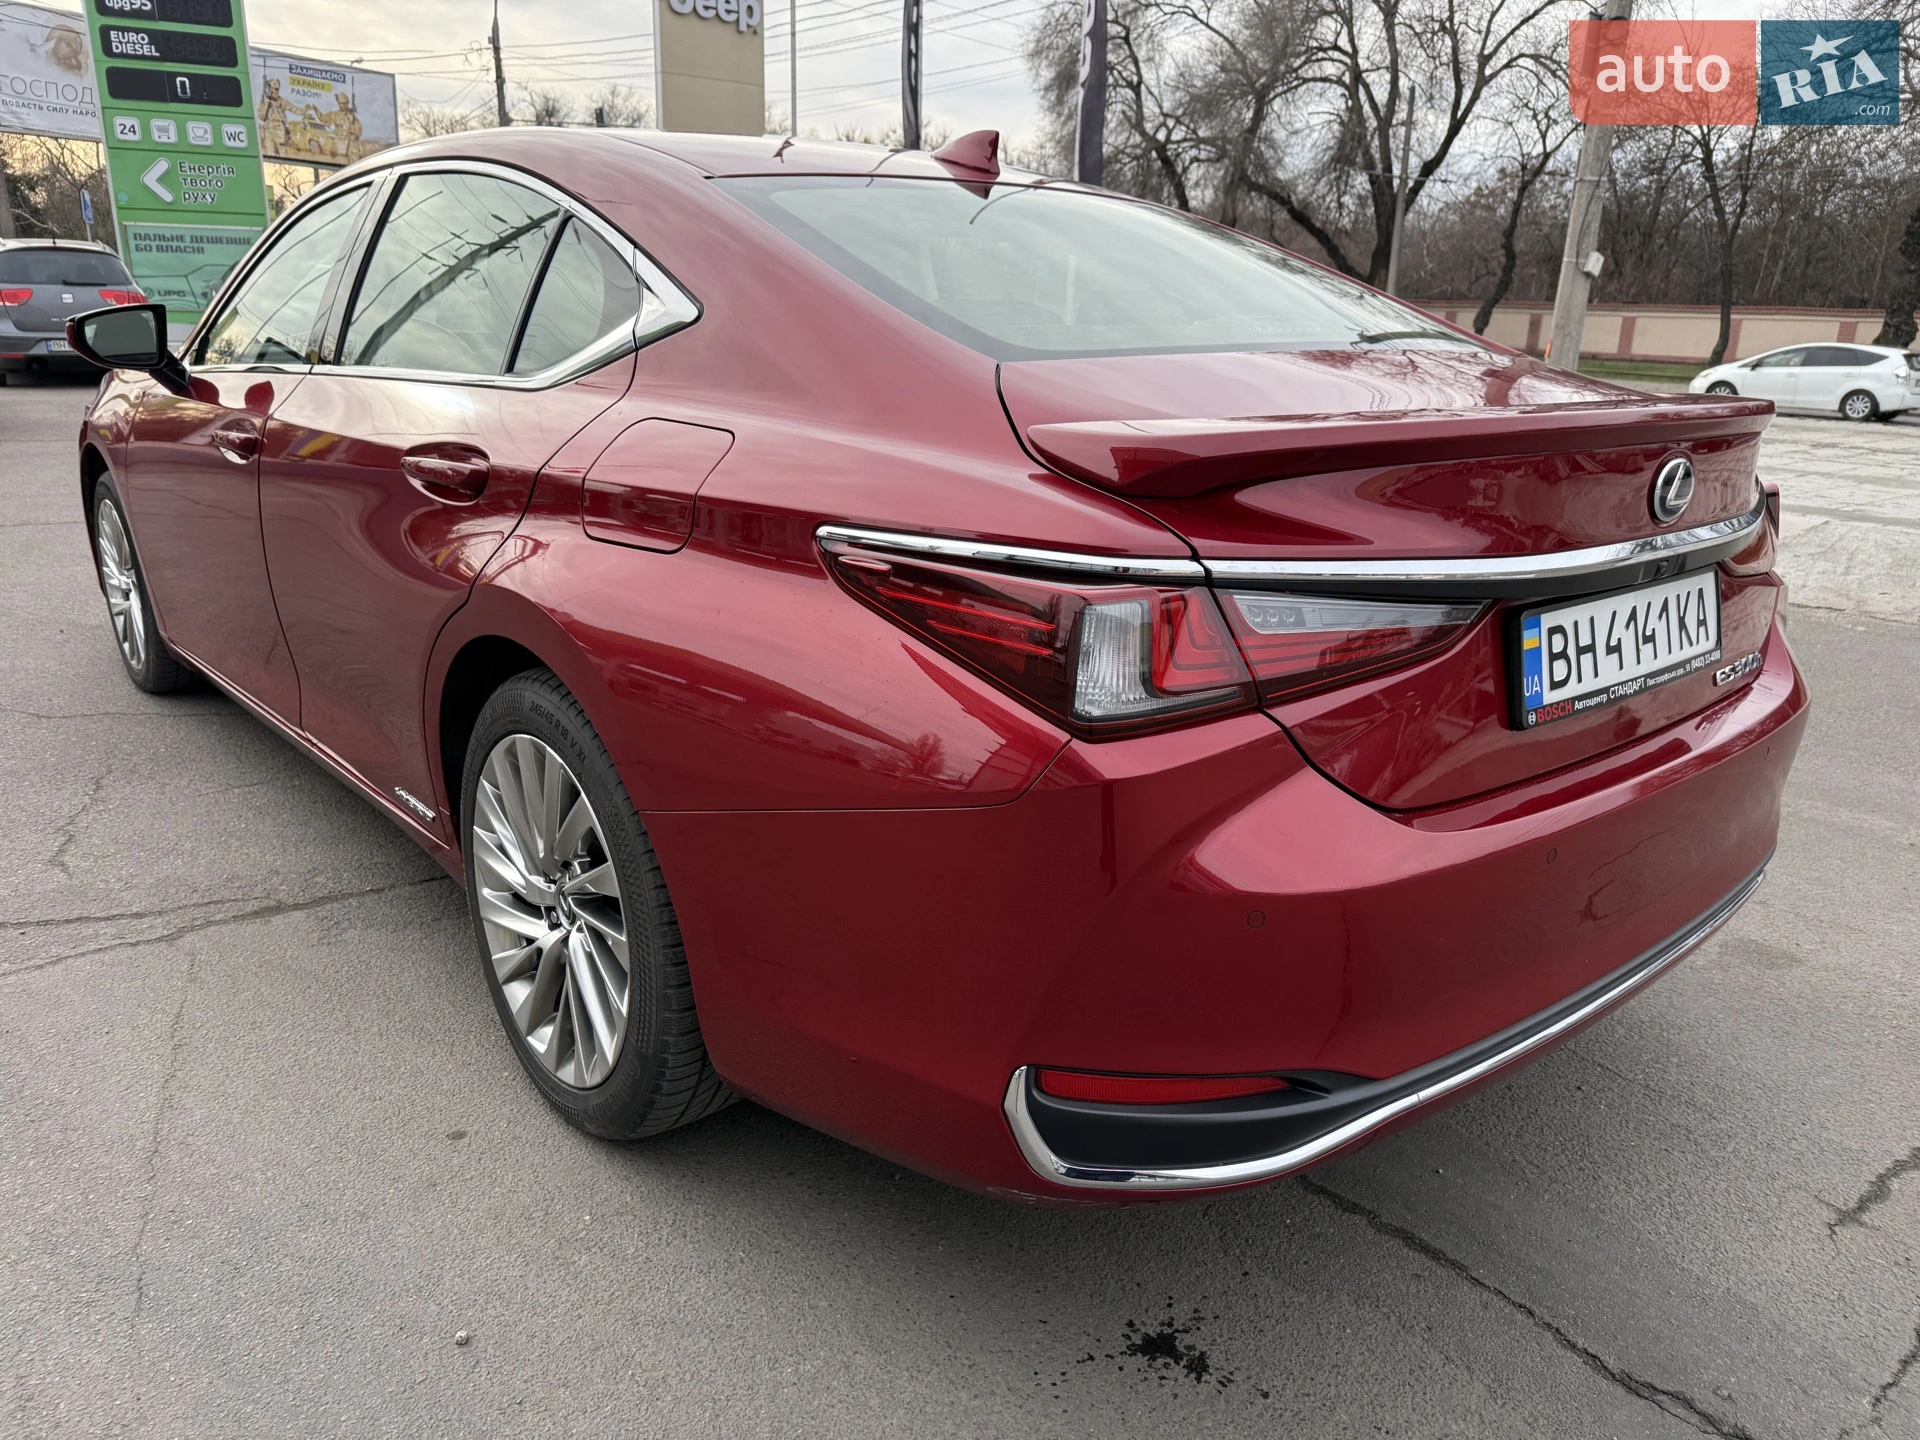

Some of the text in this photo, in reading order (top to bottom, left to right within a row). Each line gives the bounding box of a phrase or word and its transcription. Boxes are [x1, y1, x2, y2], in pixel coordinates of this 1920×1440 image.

[110, 30, 149, 44] EURO
[111, 43, 160, 56] DIESEL
[290, 65, 345, 82] ЗАХИЩАЄМО
[291, 77, 326, 90] УКРАЇНУ
[1, 99, 99, 119] ПОДАСТЬ СИЛУ НАРО
[118, 123, 137, 136] 24
[225, 130, 245, 143] WC
[178, 161, 235, 177] Енергія
[181, 177, 224, 189] твого
[183, 190, 216, 204] руху
[133, 232, 252, 246] ПАЛЬНЕ ДЕШЕВШЕ
[135, 243, 205, 255] БО ВЛАСНІ
[157, 289, 187, 298] UPG
[1523, 674, 1541, 697] UA
[1537, 699, 1573, 723] BOSCH
[1574, 693, 1608, 711] Автоцентр
[1609, 677, 1645, 699] СТАНДАРТ
[529, 701, 554, 725] 245/45
